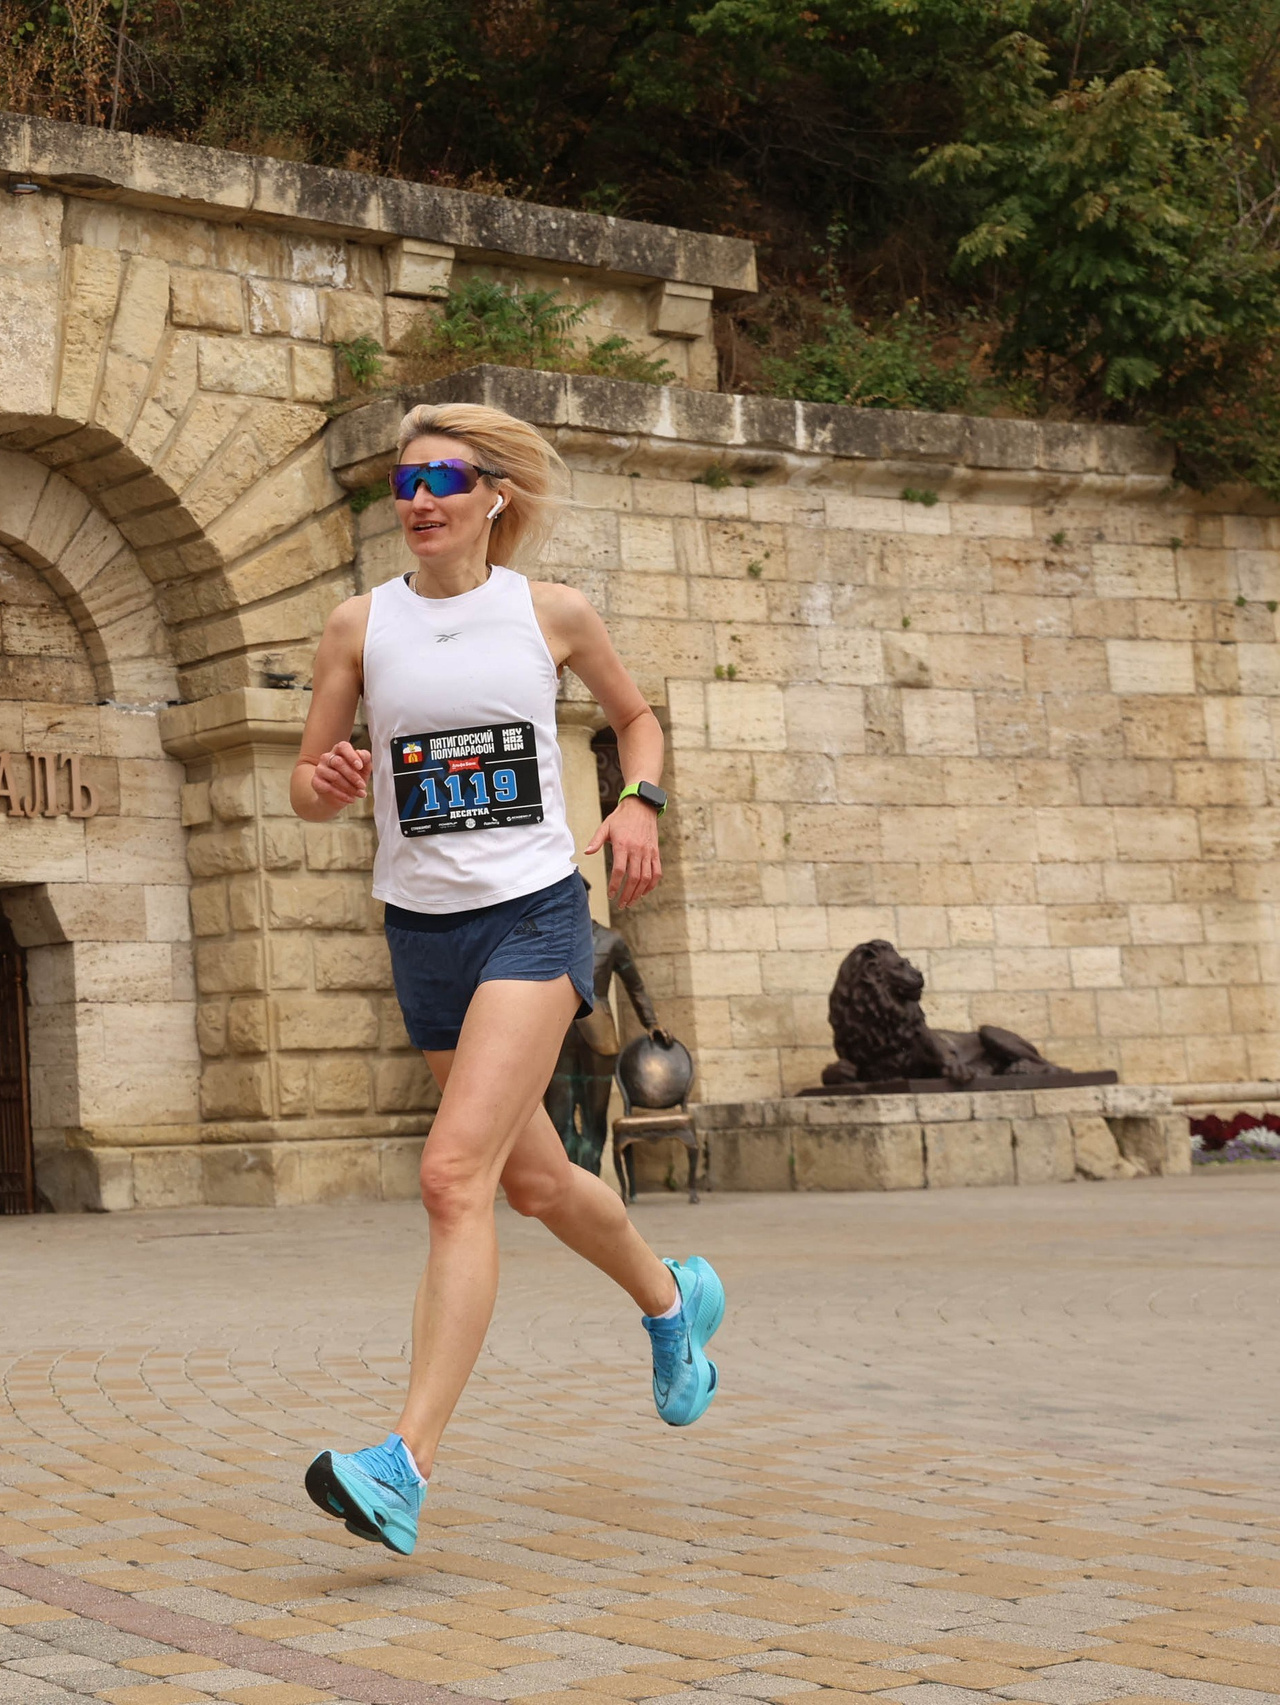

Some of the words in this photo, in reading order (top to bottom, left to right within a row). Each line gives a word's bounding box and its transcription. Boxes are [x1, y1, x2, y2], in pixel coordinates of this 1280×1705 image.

[429, 729, 494, 750] ПЯТИГОРСКИЙ
[504, 742, 525, 752] RUN
[430, 743, 495, 761] ПОЛУМАРАФОН
[420, 768, 517, 811] 1119
[450, 807, 490, 820] ДЕСЯТКА
